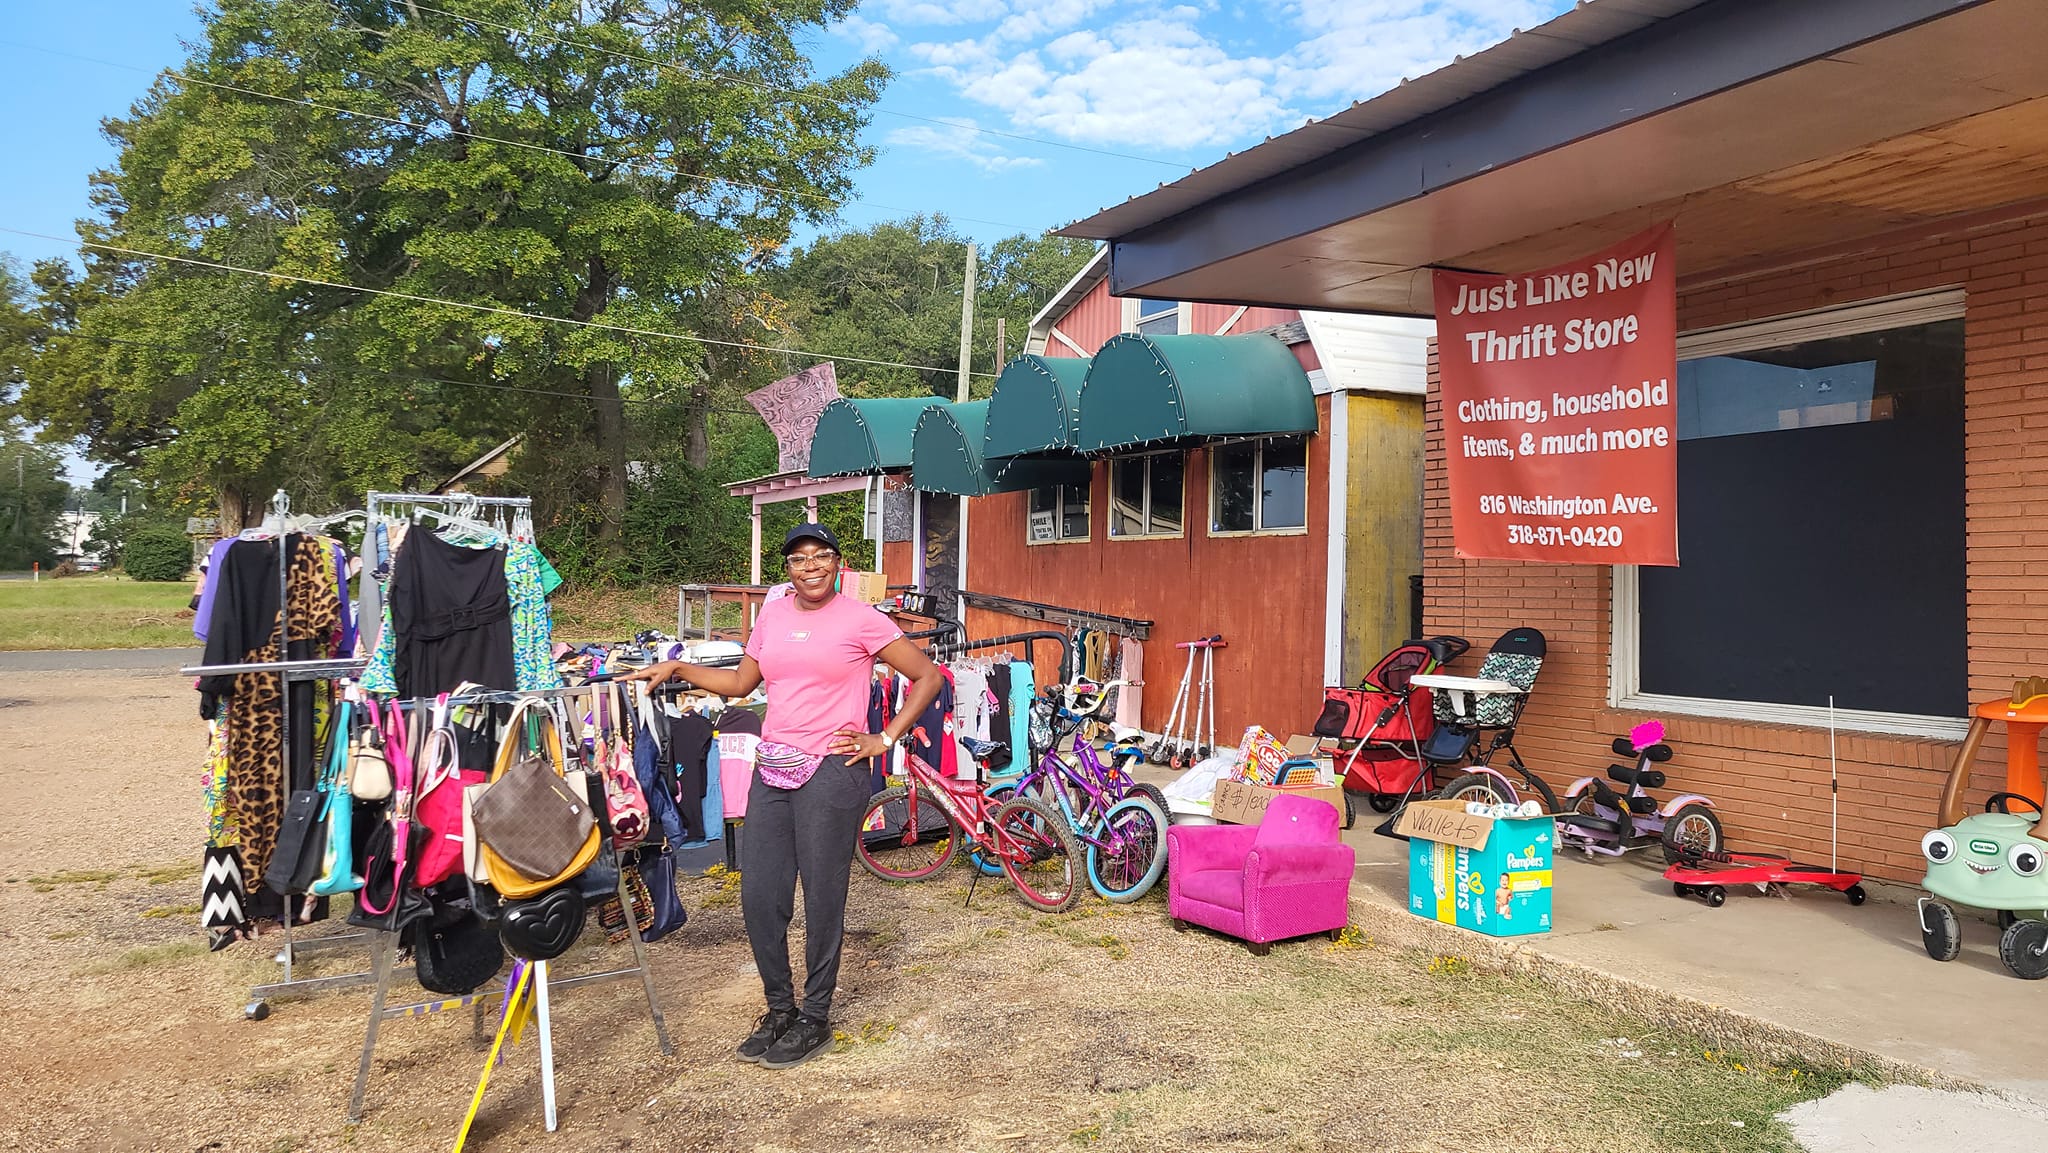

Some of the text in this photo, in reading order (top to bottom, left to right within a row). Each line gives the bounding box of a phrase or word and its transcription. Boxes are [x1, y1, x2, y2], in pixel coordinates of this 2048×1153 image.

[1450, 280, 1517, 315] Just
[1594, 252, 1656, 294] New
[1466, 314, 1639, 364] Thrift Store
[1458, 379, 1668, 424] Clothing, household
[1462, 426, 1668, 461] items, & much more
[1480, 493, 1658, 518] 816 Washington Ave.
[1508, 524, 1623, 547] 318-871-0420
[718, 735, 746, 753] ICE
[1413, 808, 1480, 839] Wallets
[1507, 852, 1544, 870] Pampers
[1455, 846, 1470, 911] ampers
